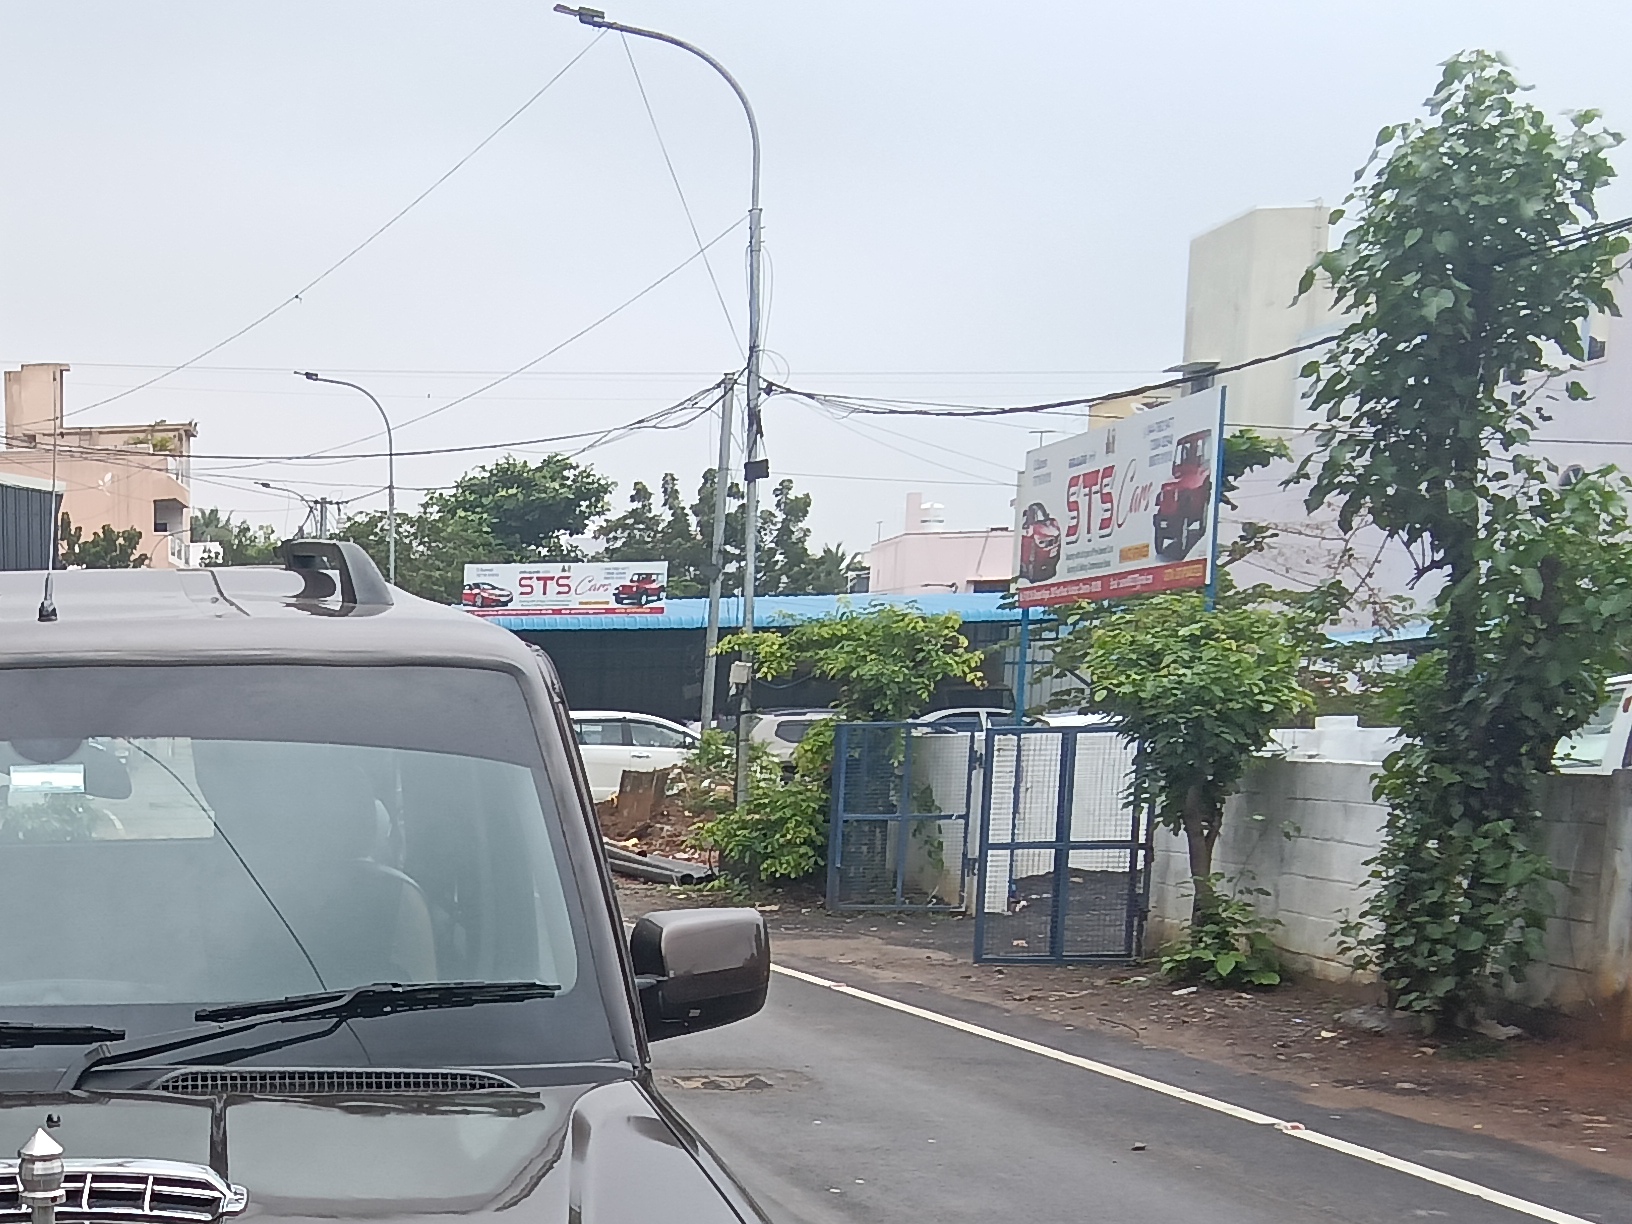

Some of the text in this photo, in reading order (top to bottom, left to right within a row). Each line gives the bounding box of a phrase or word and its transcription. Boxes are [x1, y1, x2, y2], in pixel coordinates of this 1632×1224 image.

[1066, 458, 1153, 539] STS Cars
[518, 575, 612, 596] STS Cars
